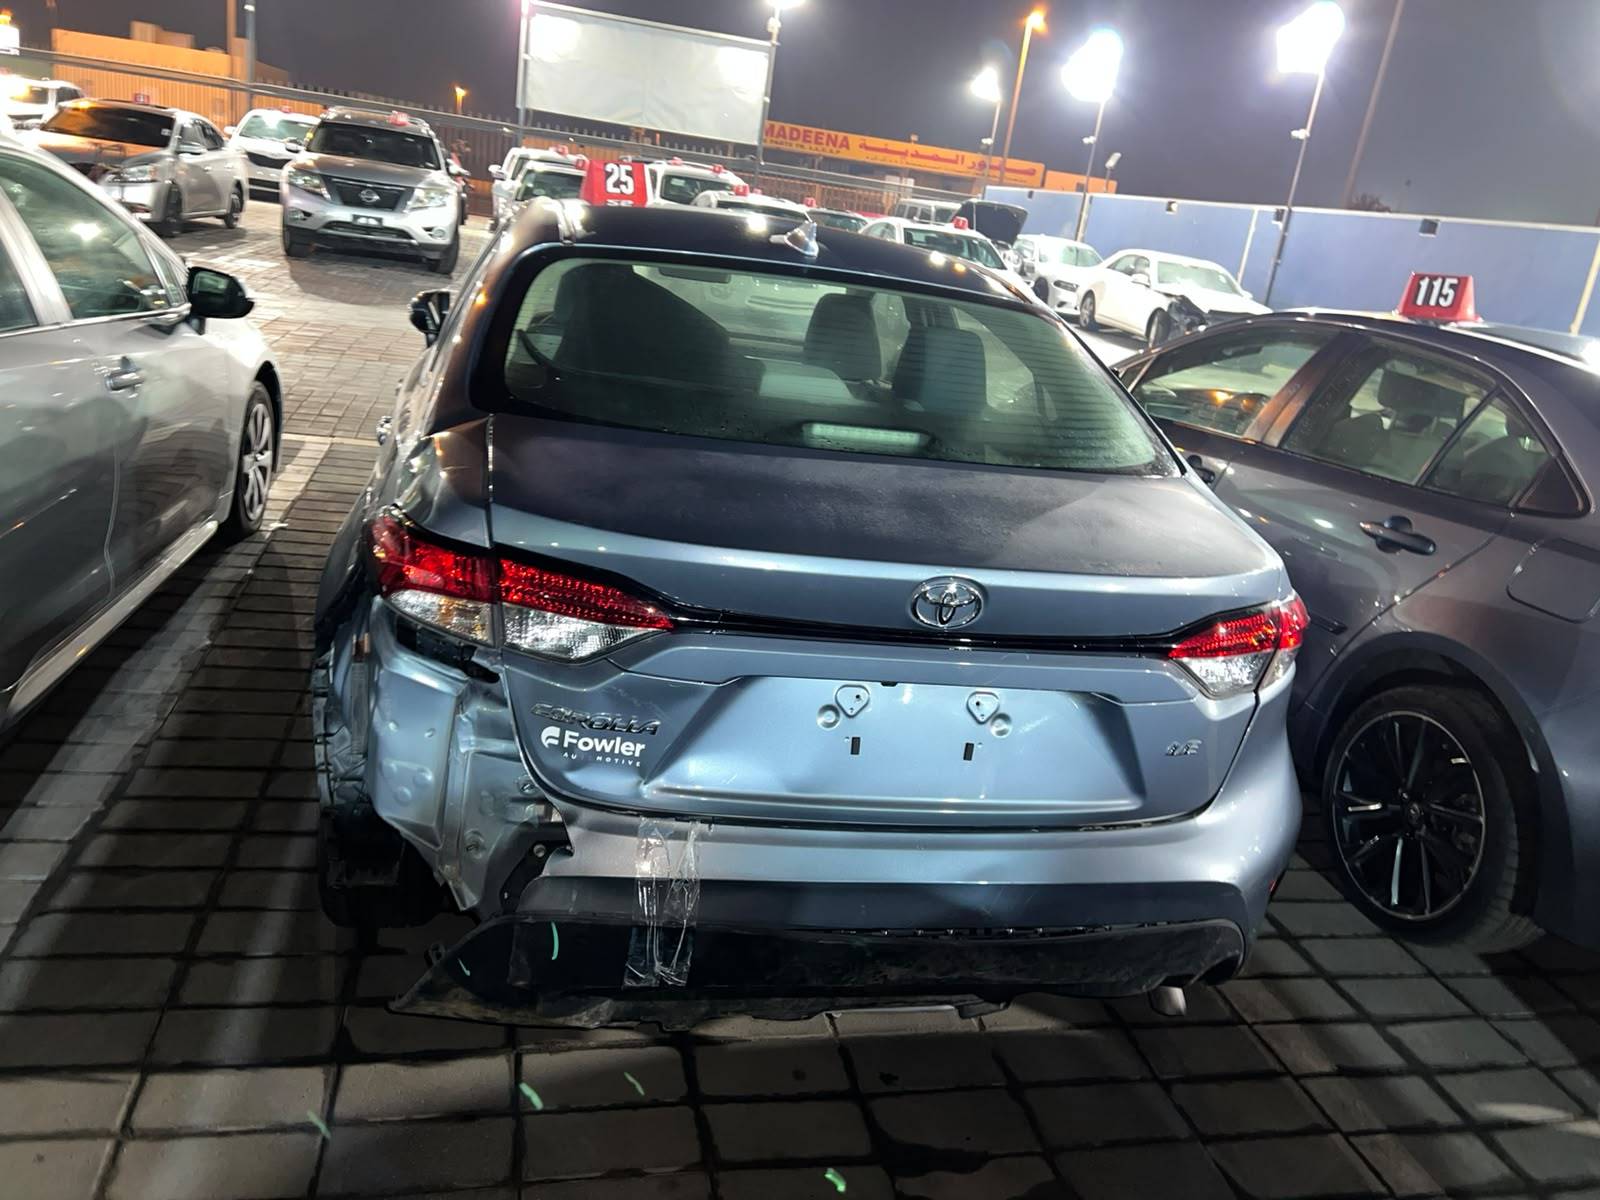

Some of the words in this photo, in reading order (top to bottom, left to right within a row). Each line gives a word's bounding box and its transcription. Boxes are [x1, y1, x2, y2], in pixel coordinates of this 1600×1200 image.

[605, 162, 635, 195] 25
[1415, 276, 1459, 307] 115
[563, 730, 646, 758] Fowler
[562, 752, 641, 767] AUMOTIVE
